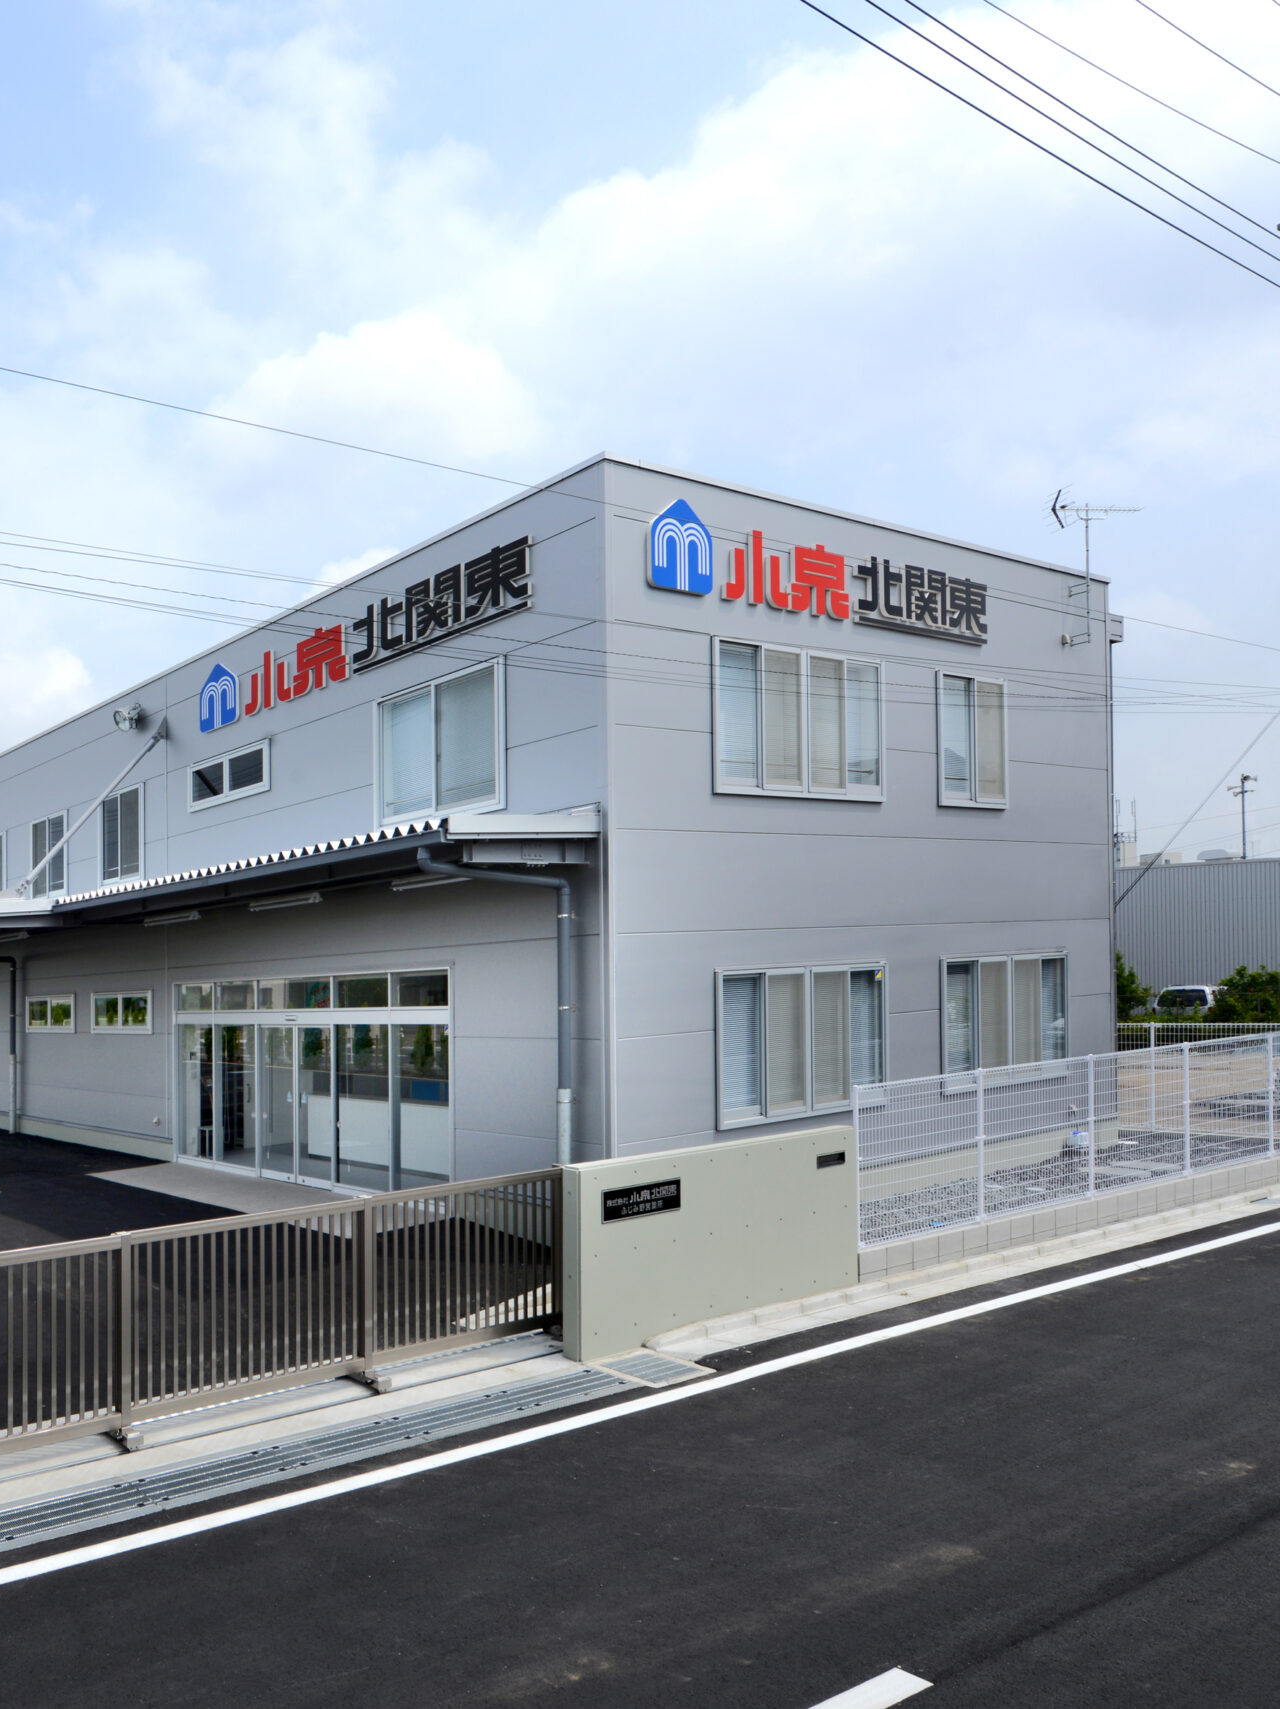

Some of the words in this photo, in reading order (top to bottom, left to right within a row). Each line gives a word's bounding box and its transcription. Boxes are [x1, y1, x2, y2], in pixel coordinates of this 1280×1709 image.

[244, 535, 533, 717] 小泉北関東
[722, 529, 988, 636] 小泉北関東
